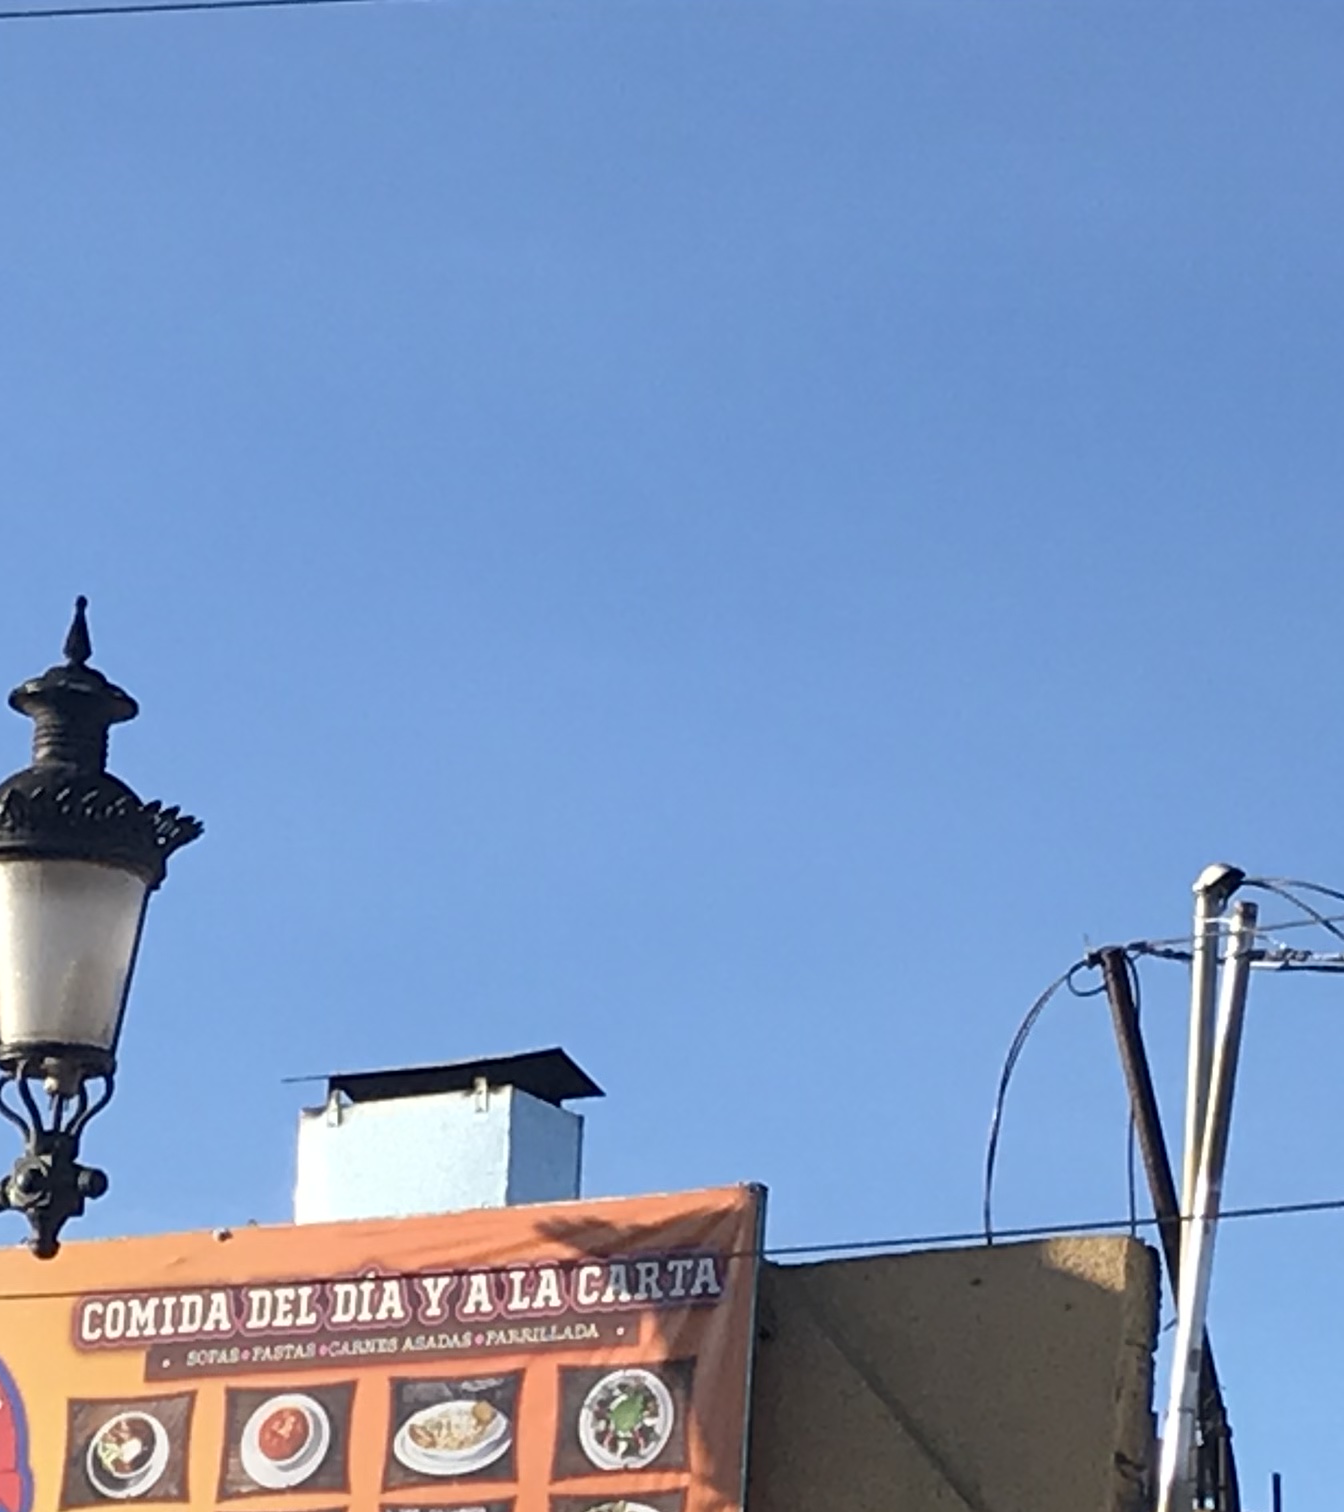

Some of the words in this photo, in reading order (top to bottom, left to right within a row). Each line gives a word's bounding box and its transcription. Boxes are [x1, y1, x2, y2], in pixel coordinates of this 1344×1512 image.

[80, 1291, 232, 1341] COMIDA
[245, 1285, 317, 1329] DEL
[329, 1270, 405, 1323] DÍA
[422, 1276, 451, 1316] Y
[462, 1273, 493, 1314] A
[506, 1267, 562, 1311] LA
[575, 1257, 721, 1305] CARTA
[251, 1342, 316, 1362] PASTAS
[327, 1336, 398, 1357] CARNES
[403, 1330, 473, 1352] ASADAS
[485, 1323, 599, 1347] PARRILLADA
